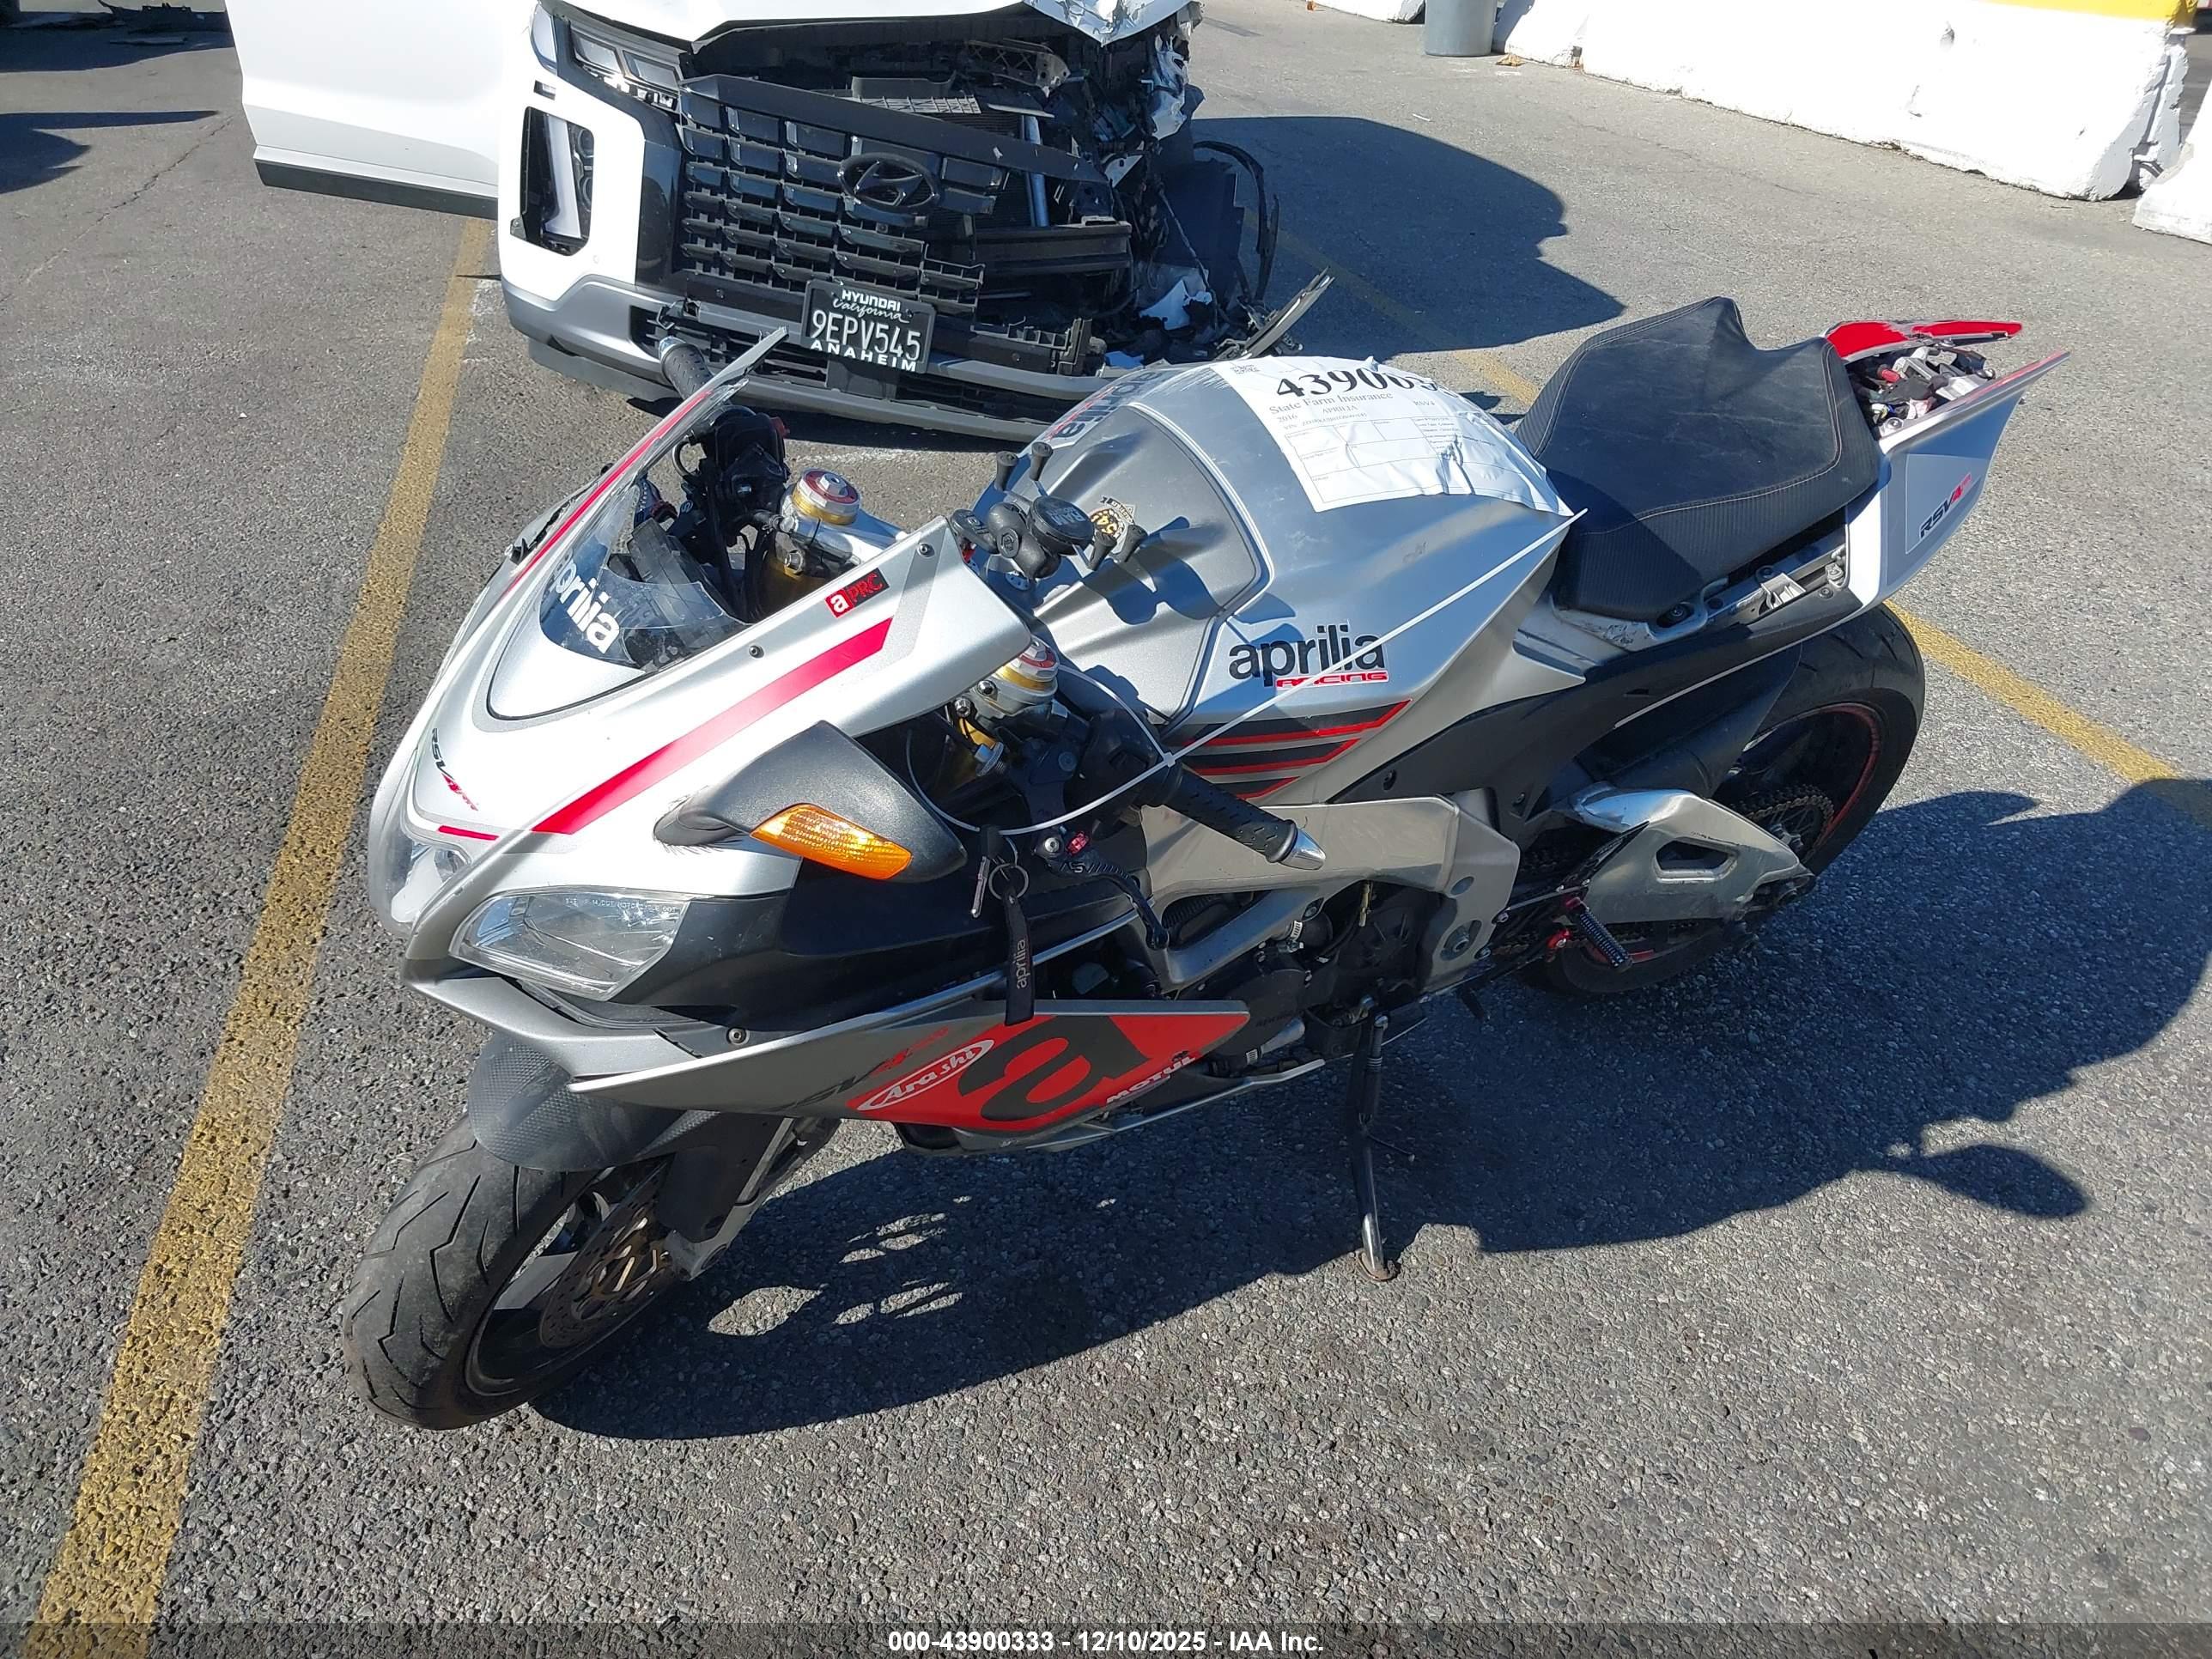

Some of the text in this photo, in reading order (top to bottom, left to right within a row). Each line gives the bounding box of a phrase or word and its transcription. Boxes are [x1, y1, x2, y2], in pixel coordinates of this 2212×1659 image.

[832, 299, 910, 324] California
[842, 289, 901, 312] HYUNDAI
[810, 309, 922, 362] 9EPV545
[810, 339, 917, 372] ANAHEIM
[1269, 392, 1394, 415] State Farm Insurance
[1228, 623, 1387, 688] aprilia
[1013, 939, 1031, 990] aprilia
[1106, 1055, 1196, 1104] MOTUL
